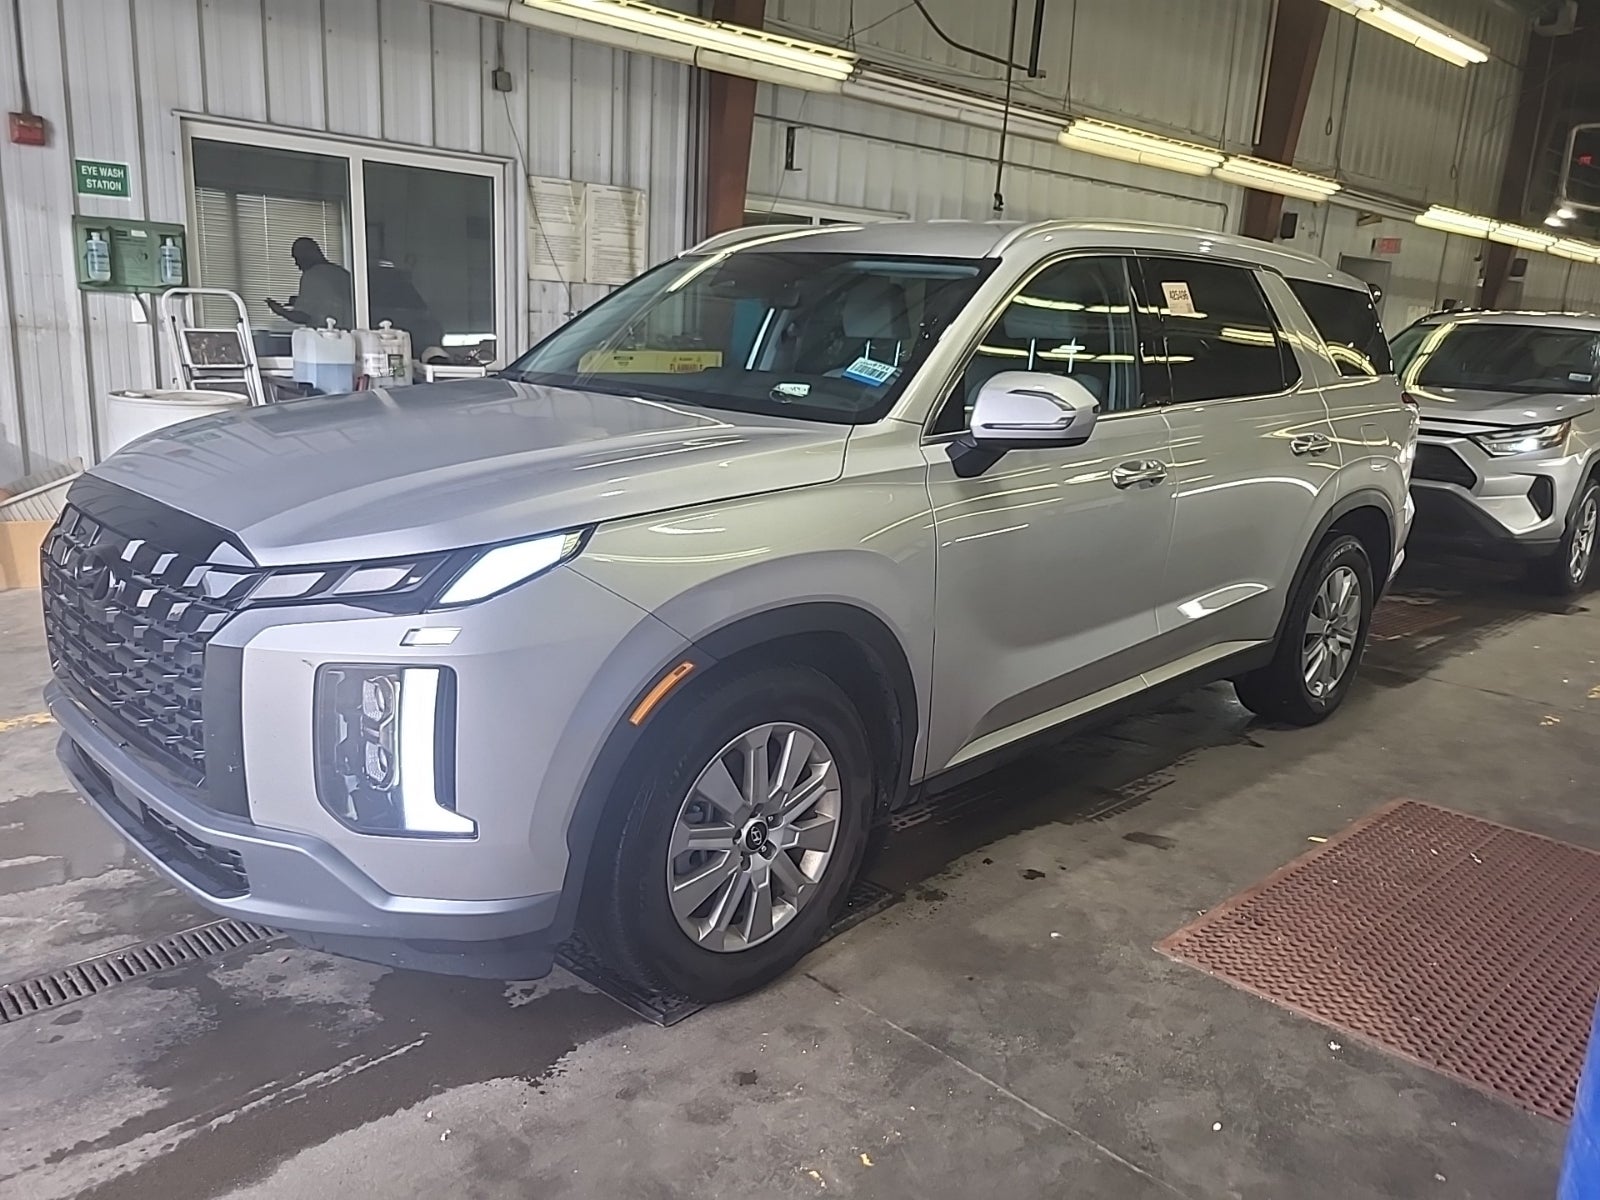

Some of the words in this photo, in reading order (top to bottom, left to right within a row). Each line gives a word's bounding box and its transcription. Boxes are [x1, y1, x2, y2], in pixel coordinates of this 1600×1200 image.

[81, 165, 98, 176] EYE
[99, 166, 124, 178] WASH
[86, 178, 122, 191] STATION
